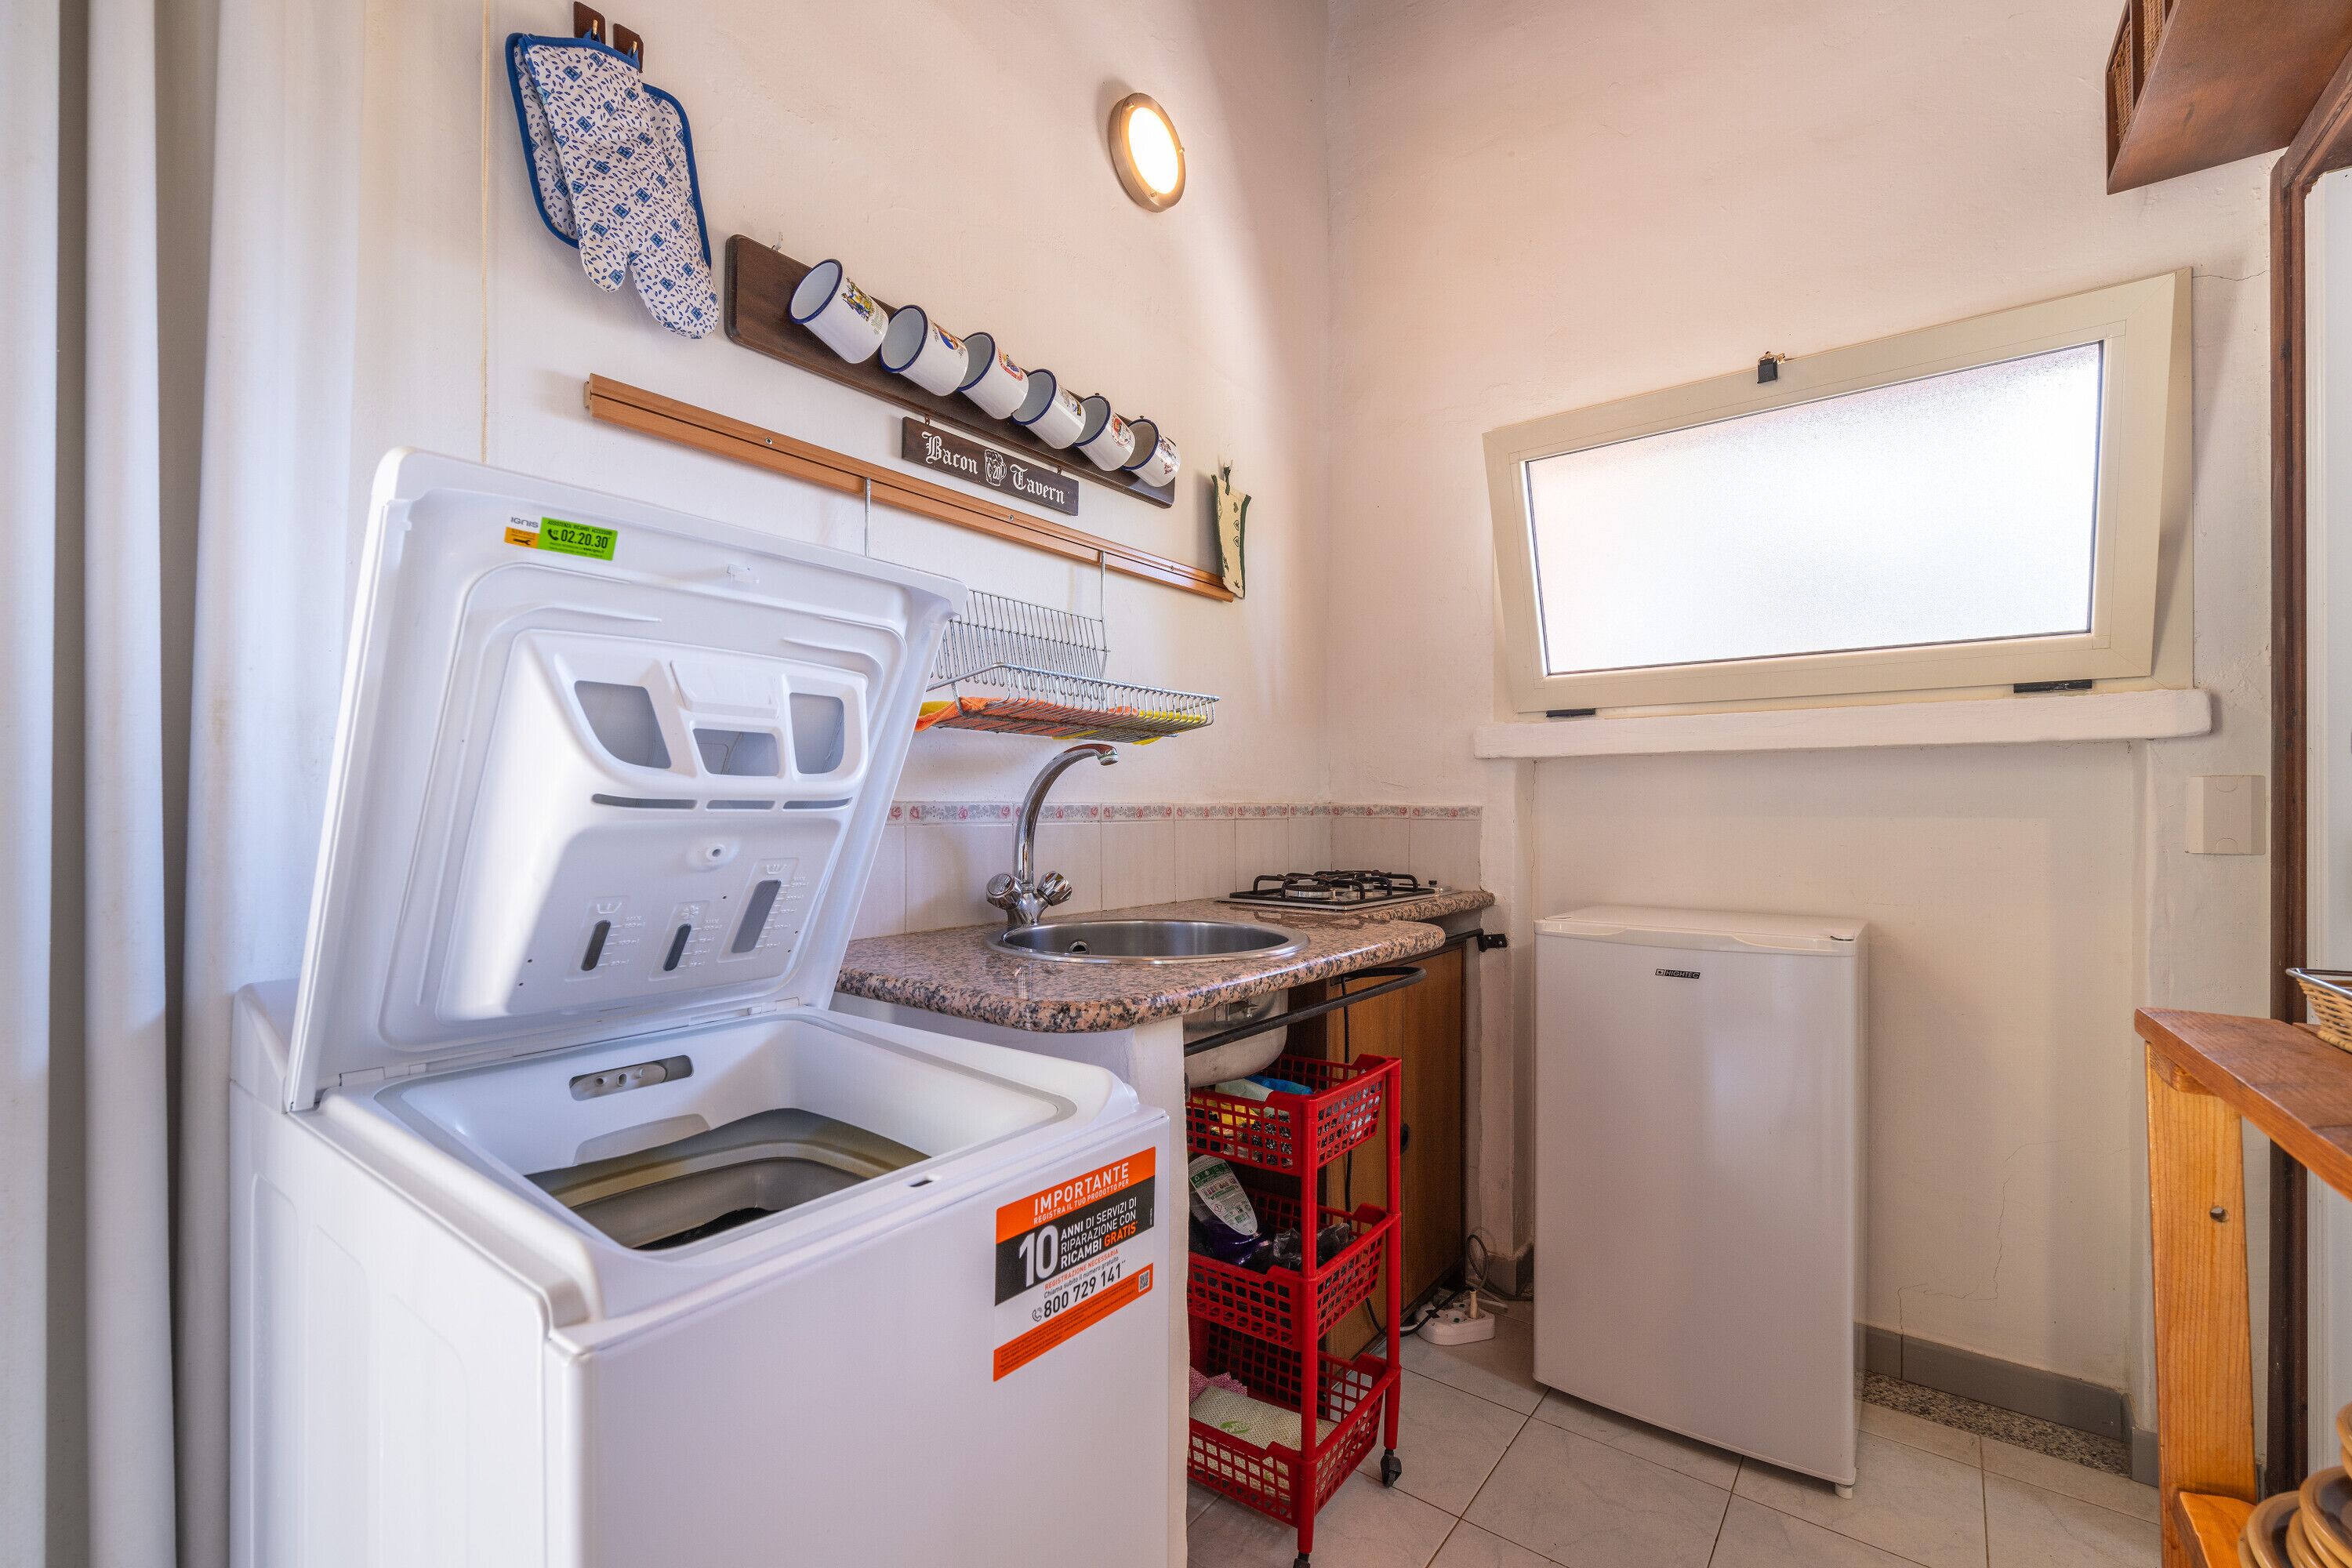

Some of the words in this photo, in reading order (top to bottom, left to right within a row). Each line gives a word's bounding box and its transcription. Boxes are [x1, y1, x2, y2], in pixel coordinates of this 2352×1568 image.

[921, 431, 978, 474] Bacon
[1010, 463, 1065, 505] Tavern
[510, 517, 539, 528] IGNIS
[1665, 969, 1700, 978] HIGHTEC
[1033, 1204, 1066, 1225] REGISTRA
[1066, 1202, 1073, 1211] IL
[1074, 1196, 1087, 1208] TUO
[1087, 1185, 1117, 1203] PRODOTTO
[1118, 1178, 1129, 1189] PER
[1034, 1162, 1129, 1216] IMPORTANTE
[1061, 1221, 1083, 1242] ANNI
[1086, 1217, 1094, 1230] DI
[1096, 1200, 1127, 1223] SERVIZI
[1129, 1196, 1137, 1209] DI
[1061, 1220, 1118, 1254] RIPARAZIONE
[1120, 1210, 1136, 1226] CON
[1018, 1225, 1058, 1287] 10
[1044, 1265, 1087, 1291] REGISTRAZIONE
[1087, 1247, 1119, 1268] NECESSARIA
[1061, 1240, 1102, 1269] RICAMBI
[1044, 1285, 1063, 1298] Chiama
[1063, 1278, 1079, 1289] subito
[1083, 1265, 1101, 1280] numero
[1101, 1256, 1120, 1271] gratuito
[1044, 1290, 1069, 1318] 800
[1073, 1276, 1097, 1303] 729
